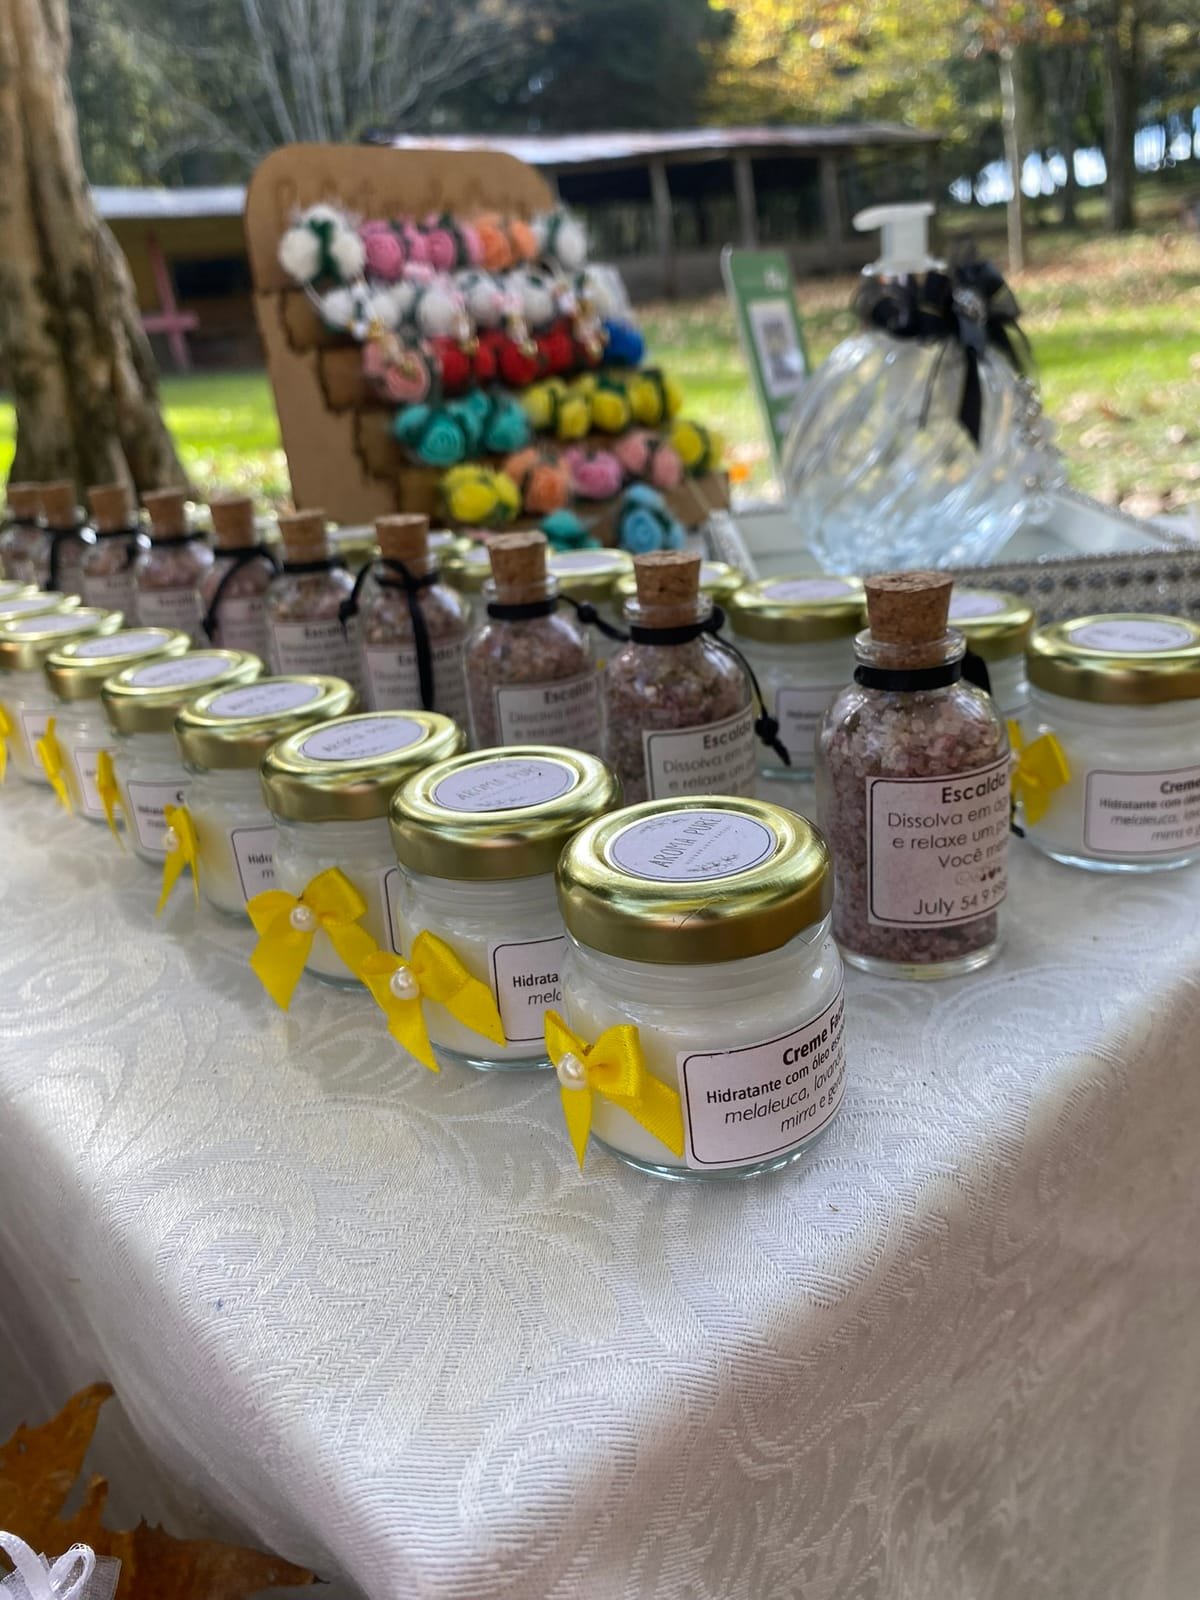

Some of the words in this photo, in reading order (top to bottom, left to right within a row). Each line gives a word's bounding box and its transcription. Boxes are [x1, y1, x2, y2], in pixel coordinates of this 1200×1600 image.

[1099, 797, 1158, 810] Hidratante
[887, 812, 963, 828] Dissolva
[967, 805, 991, 822] em
[648, 836, 698, 868] AROMA
[682, 816, 724, 837] PURE
[892, 837, 905, 849] e
[911, 833, 968, 849] relaxe
[972, 827, 994, 843] um
[938, 848, 983, 869] Você
[913, 897, 955, 917] July
[960, 894, 978, 911] 54
[512, 972, 559, 988] Hidrata
[782, 1027, 828, 1066] Creme
[706, 1079, 782, 1104] Hidratante
[785, 1065, 809, 1086] com
[812, 1048, 830, 1071] óleo
[724, 1087, 811, 1125] melaleuca,
[780, 1104, 817, 1133] mirra
[819, 1095, 826, 1109] e
